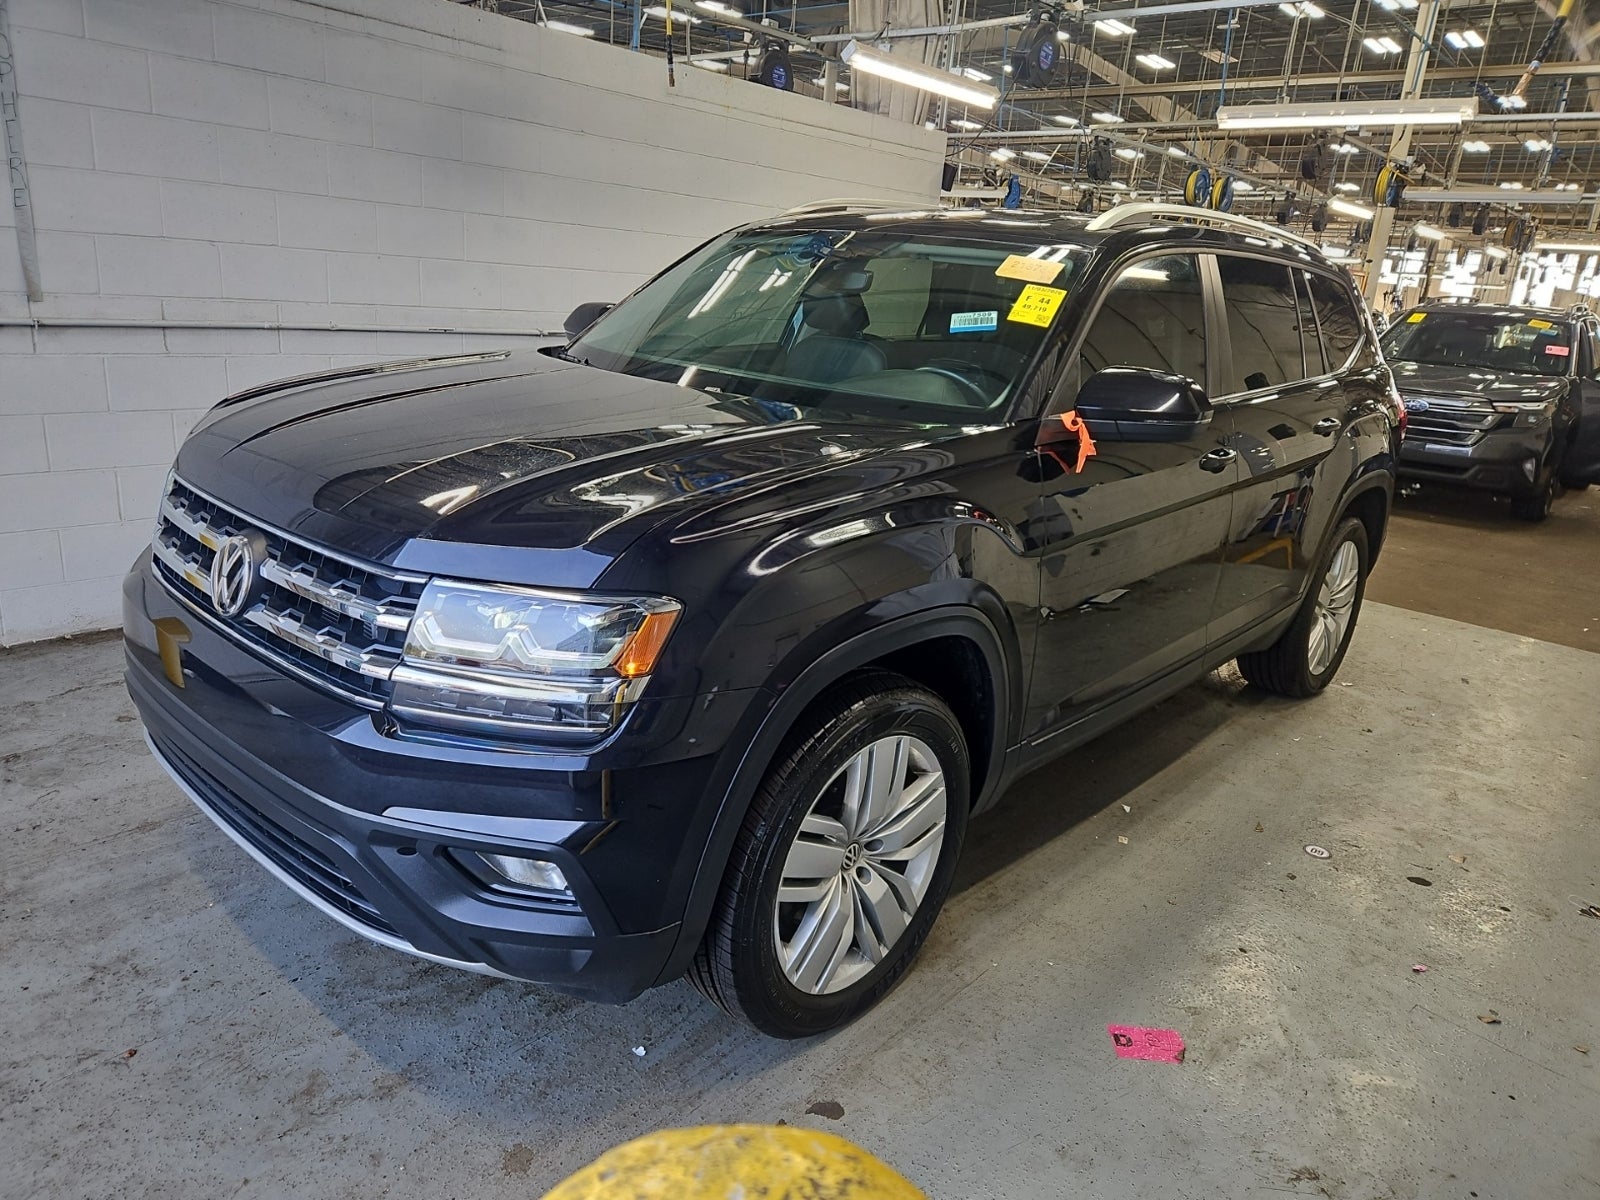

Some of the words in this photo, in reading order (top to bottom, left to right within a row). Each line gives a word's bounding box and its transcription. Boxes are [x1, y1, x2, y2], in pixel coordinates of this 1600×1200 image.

[1, 91, 28, 208] HERE
[1038, 297, 1051, 305] 44
[211, 535, 253, 617] VW
